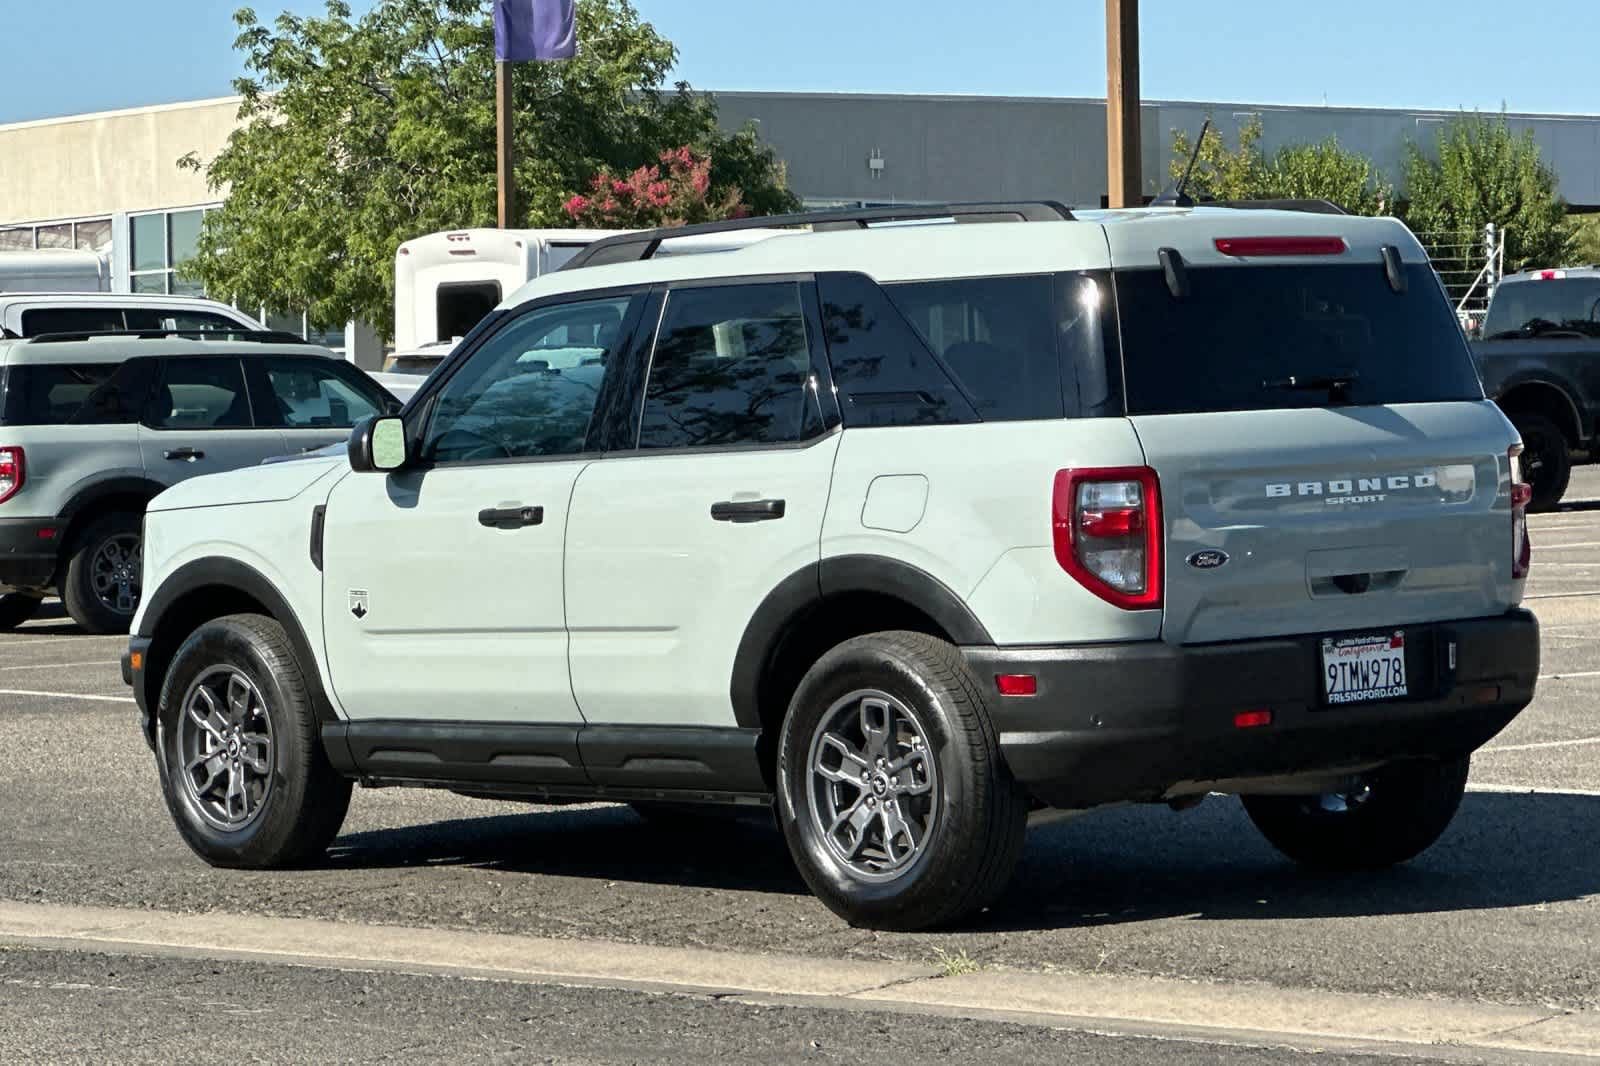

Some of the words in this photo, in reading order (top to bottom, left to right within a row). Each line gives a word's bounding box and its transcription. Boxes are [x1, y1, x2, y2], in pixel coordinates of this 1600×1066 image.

[1265, 474, 1436, 497] BRONCO
[1325, 494, 1387, 505] SPORT
[1328, 657, 1402, 694] 9TMW978
[1328, 686, 1408, 704] FRESNOFORD.COM
